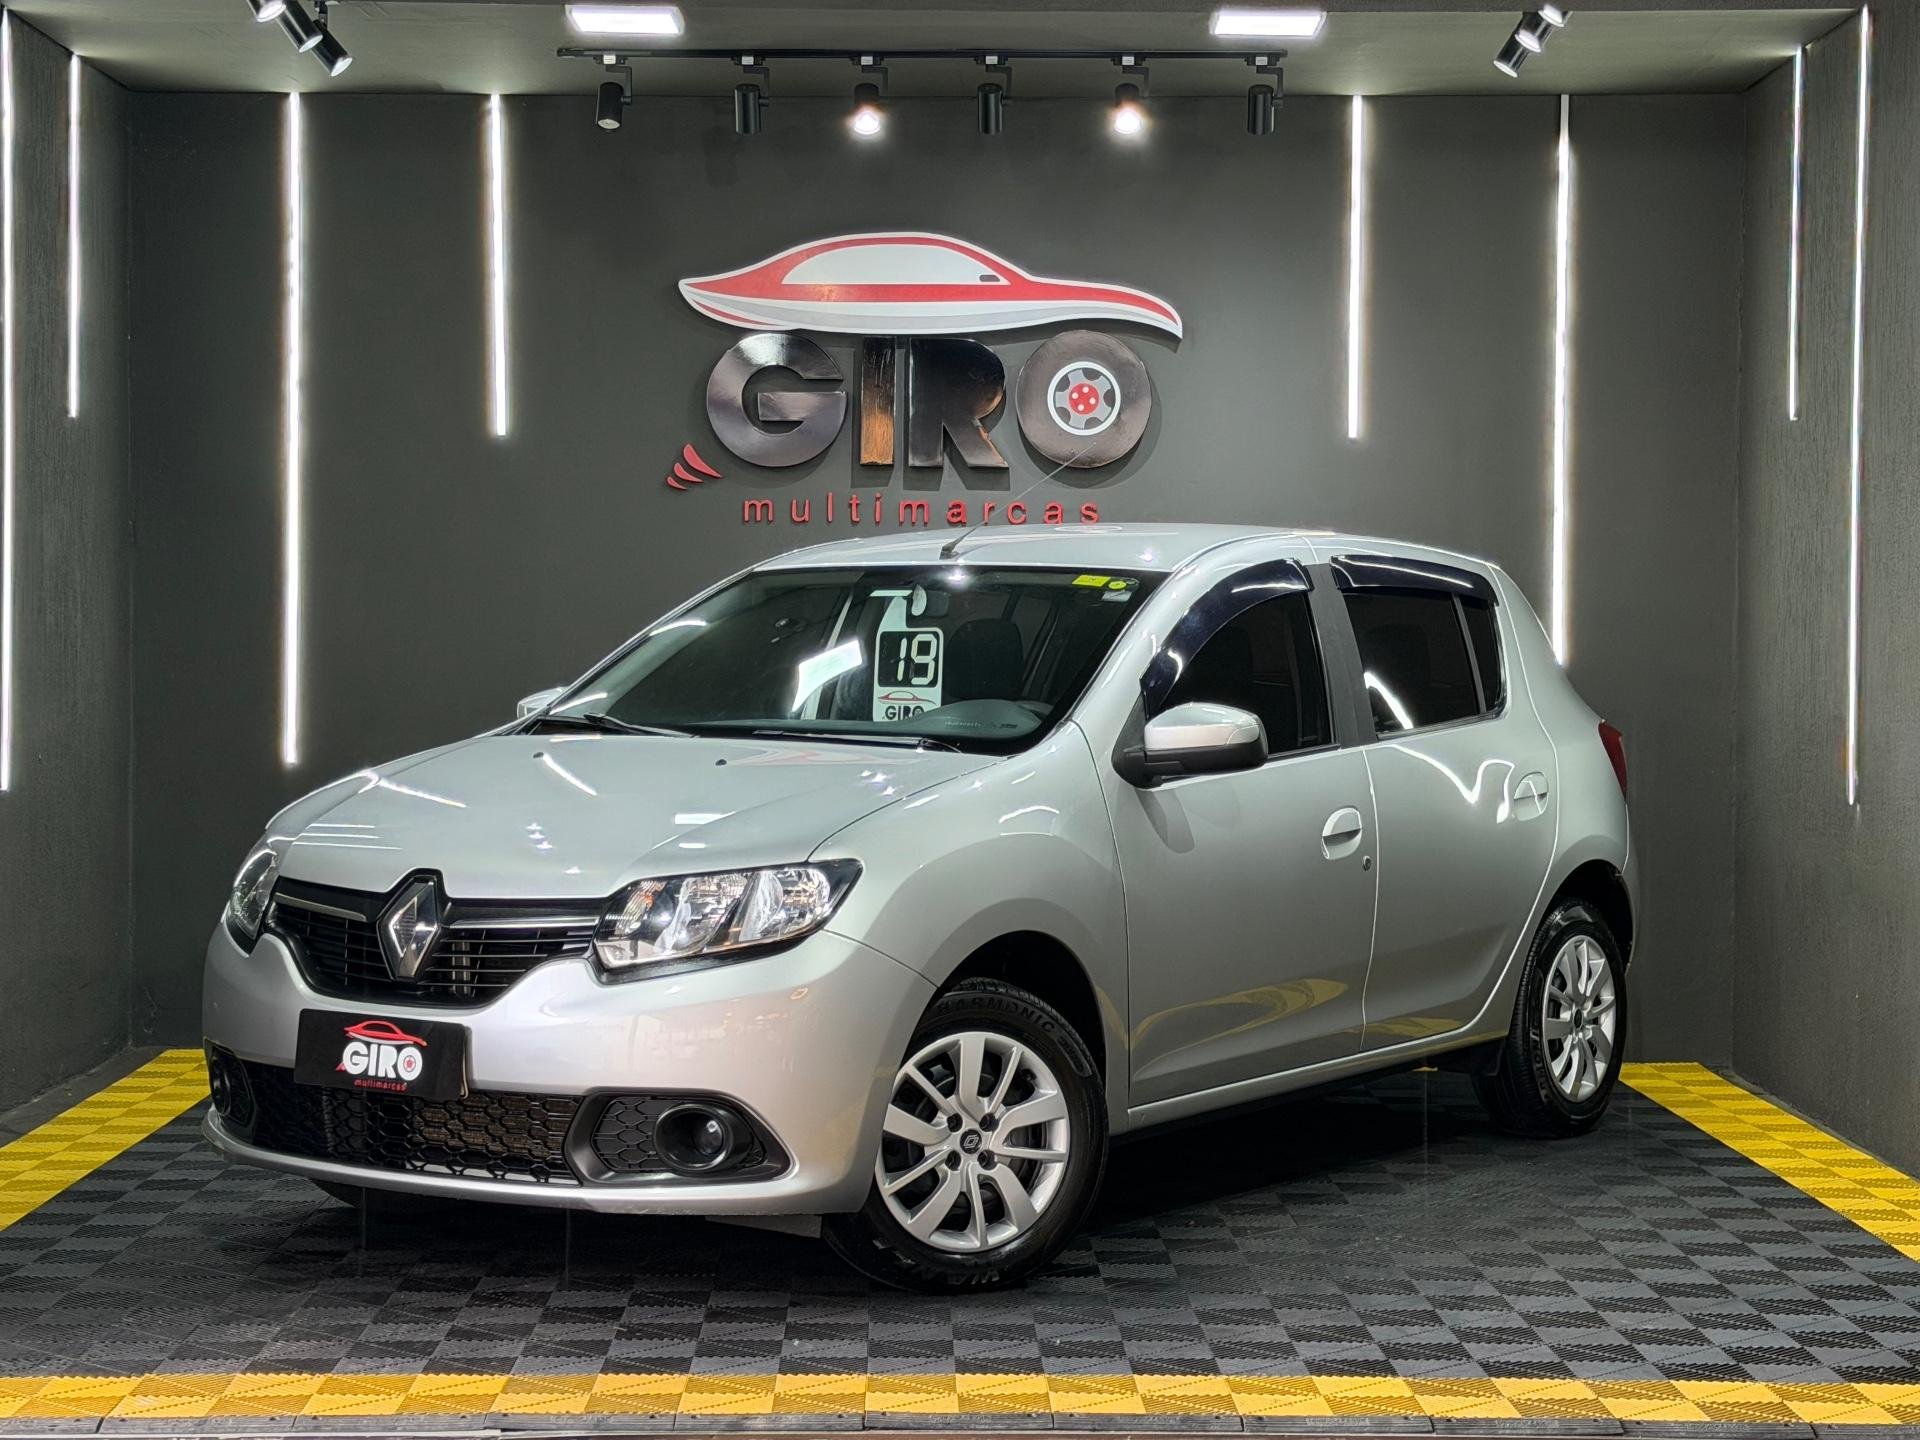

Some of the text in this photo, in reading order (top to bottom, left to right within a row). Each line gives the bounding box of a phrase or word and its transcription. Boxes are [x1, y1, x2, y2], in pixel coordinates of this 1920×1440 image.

[706, 329, 1152, 468] GIRO
[743, 492, 1101, 526] multimarcas
[896, 633, 938, 686] 19
[342, 1041, 423, 1081] GIRO
[354, 1078, 408, 1093] multimarcas
